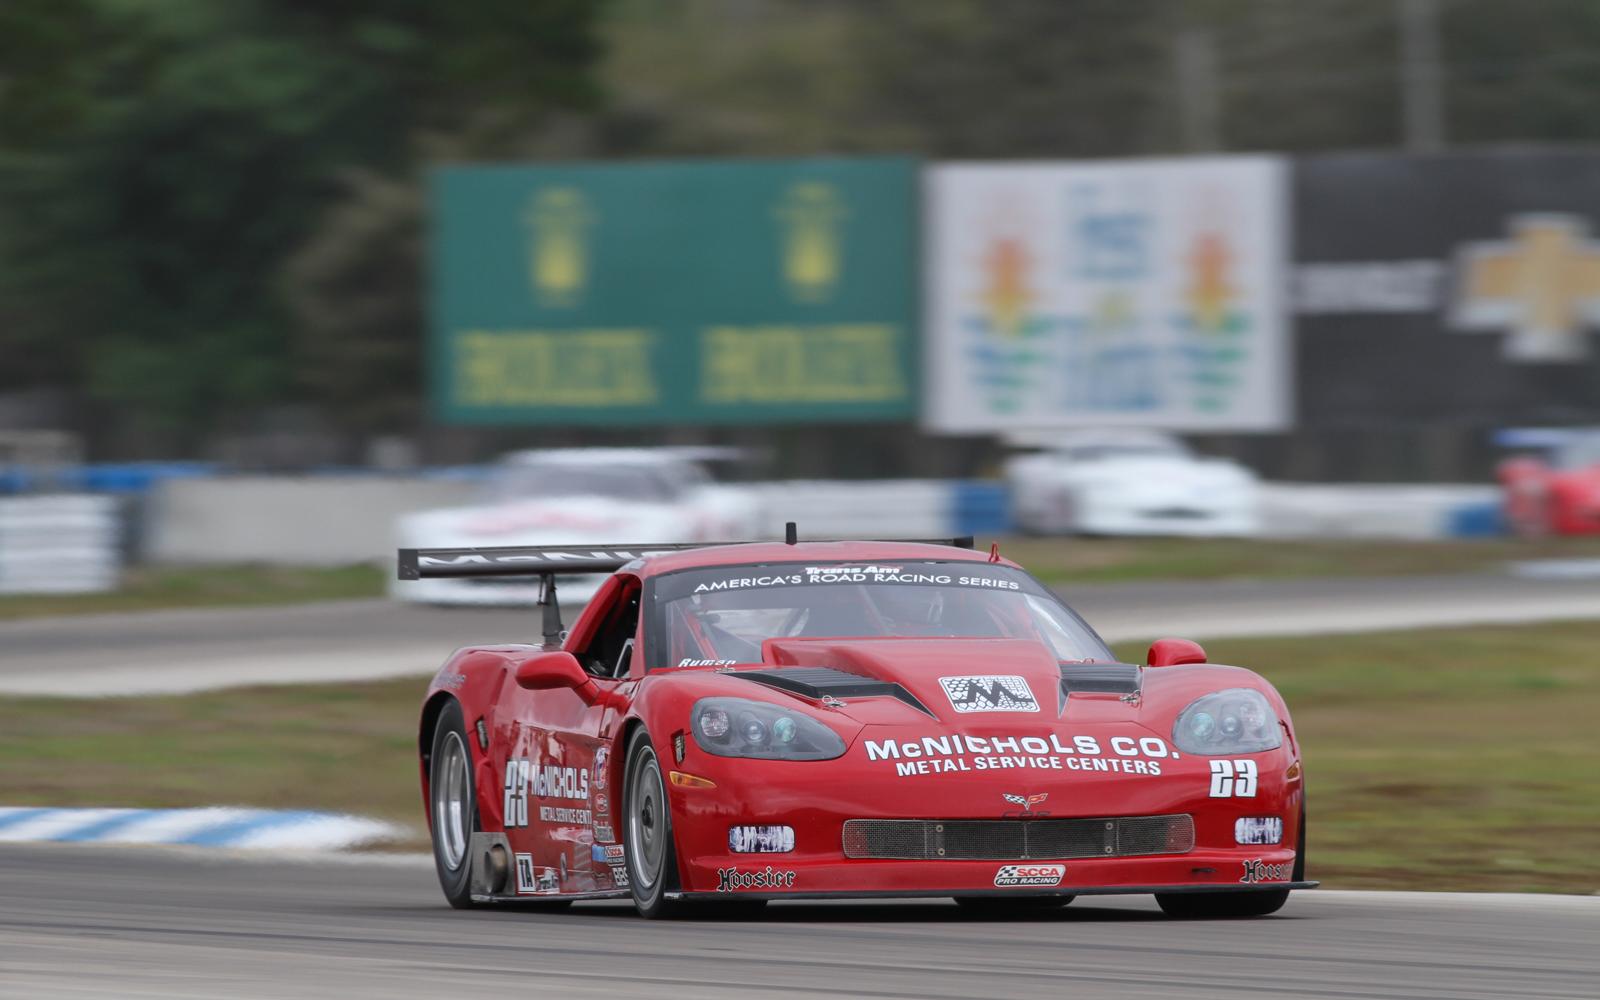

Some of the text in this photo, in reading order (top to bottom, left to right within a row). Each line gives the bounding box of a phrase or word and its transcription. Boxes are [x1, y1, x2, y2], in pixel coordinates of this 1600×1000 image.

[694, 573, 1020, 593] AMERICA'S ROAD RACING SERIES
[864, 734, 1180, 761] McNICHOLS CO.
[895, 756, 1162, 777] METAL SERVICE CENTERS
[1208, 759, 1258, 798] 23
[504, 760, 529, 827] 23
[531, 765, 588, 799] McNICHOLS
[519, 859, 534, 888] TA
[716, 866, 797, 892] Hoosier
[997, 877, 1018, 885] PRO
[1016, 868, 1060, 877] SCCA
